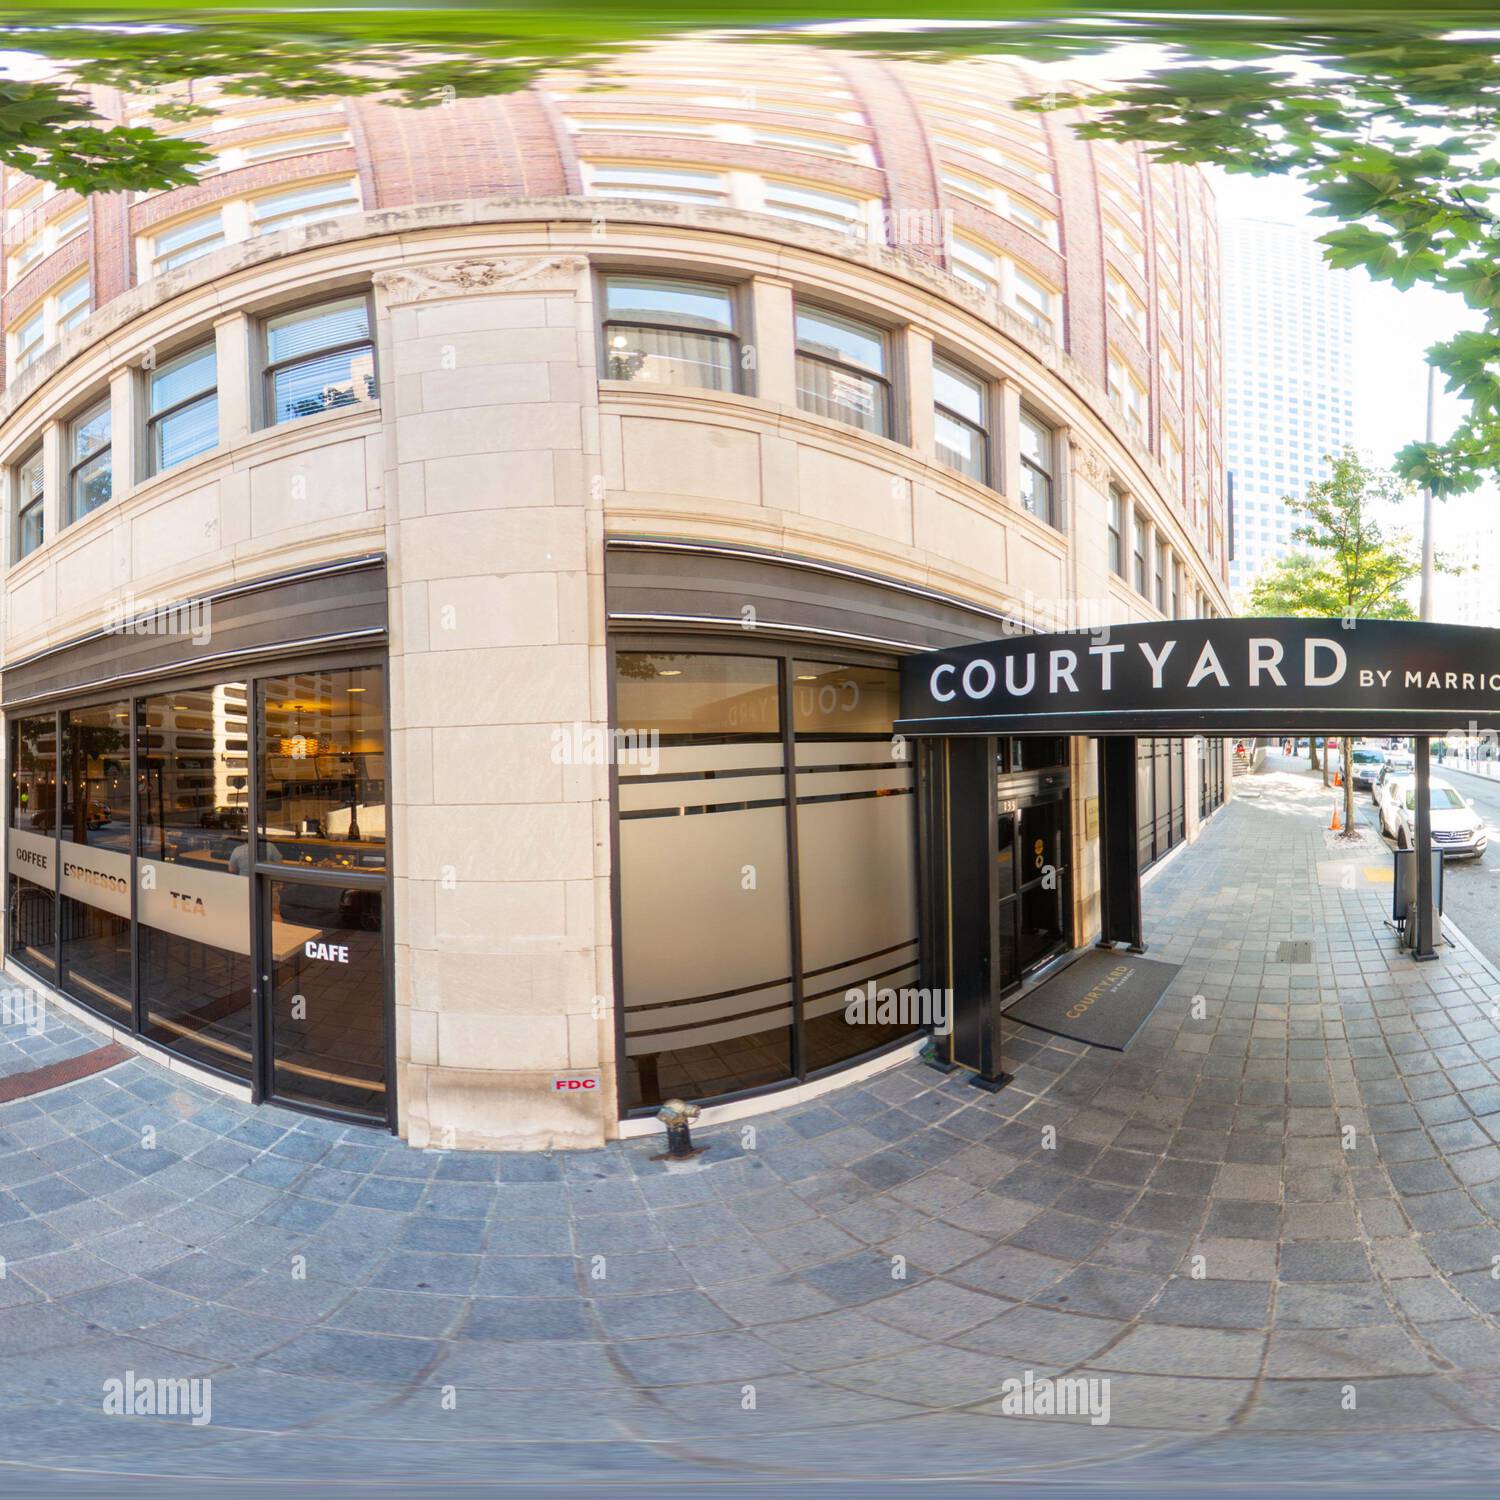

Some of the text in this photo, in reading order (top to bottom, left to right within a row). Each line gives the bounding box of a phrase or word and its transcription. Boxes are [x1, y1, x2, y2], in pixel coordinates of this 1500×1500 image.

[930, 638, 1347, 702] COURTYARD
[1359, 670, 1392, 687] BY
[16, 848, 206, 917] COFFEE ESPRESSO TEA
[305, 941, 349, 963] CAFE
[1066, 966, 1128, 1019] COURTYARD
[556, 1079, 596, 1090] FDC
